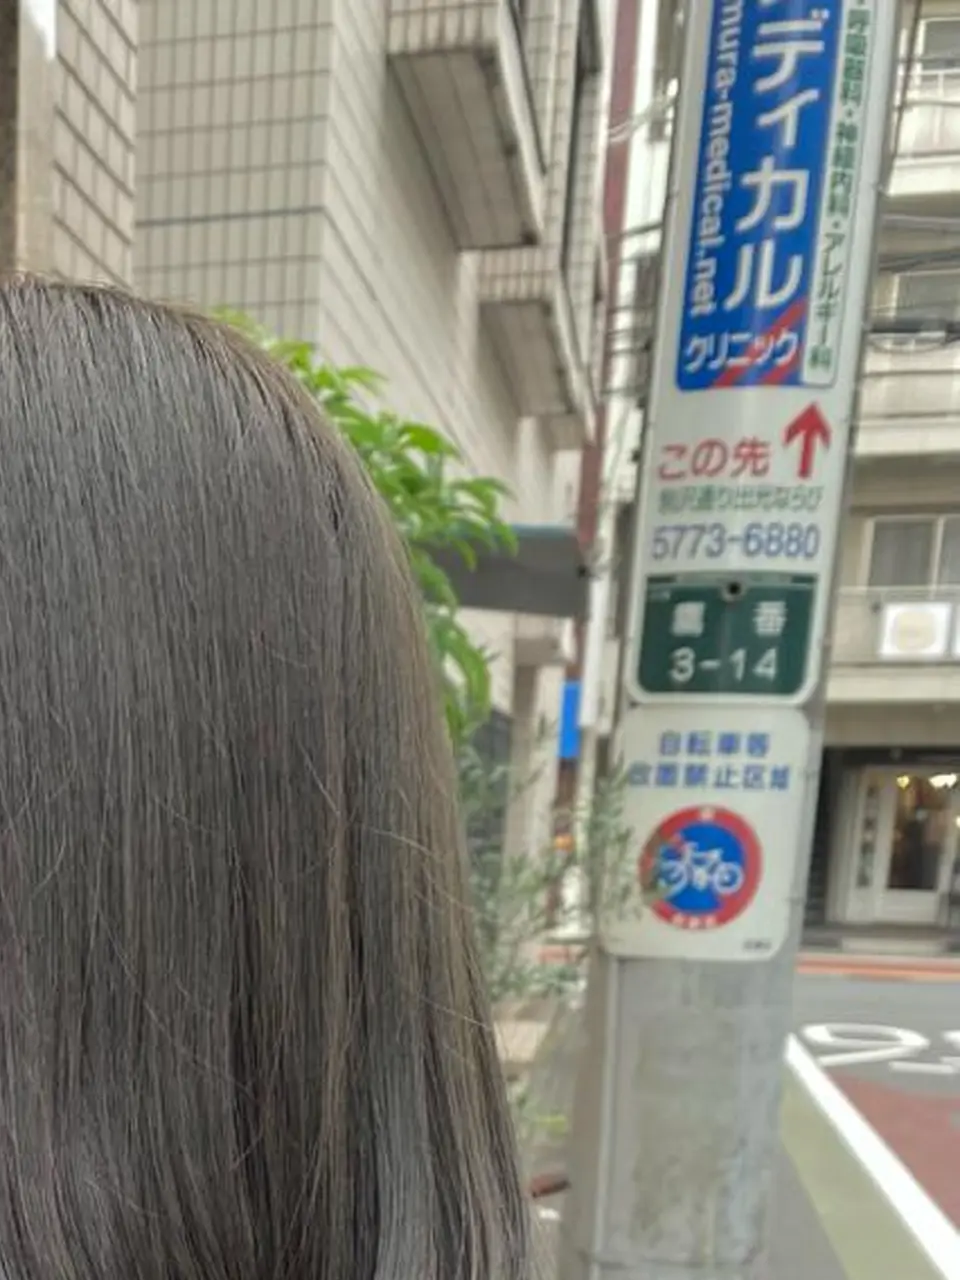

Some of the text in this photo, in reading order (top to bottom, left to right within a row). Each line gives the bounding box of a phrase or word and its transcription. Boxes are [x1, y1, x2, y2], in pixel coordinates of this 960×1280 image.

[723, 0, 830, 312] ディカル
[684, 328, 800, 373] クリニック
[657, 436, 771, 480] この先
[652, 521, 820, 561] 5773-6880
[669, 646, 778, 683] 3-14
